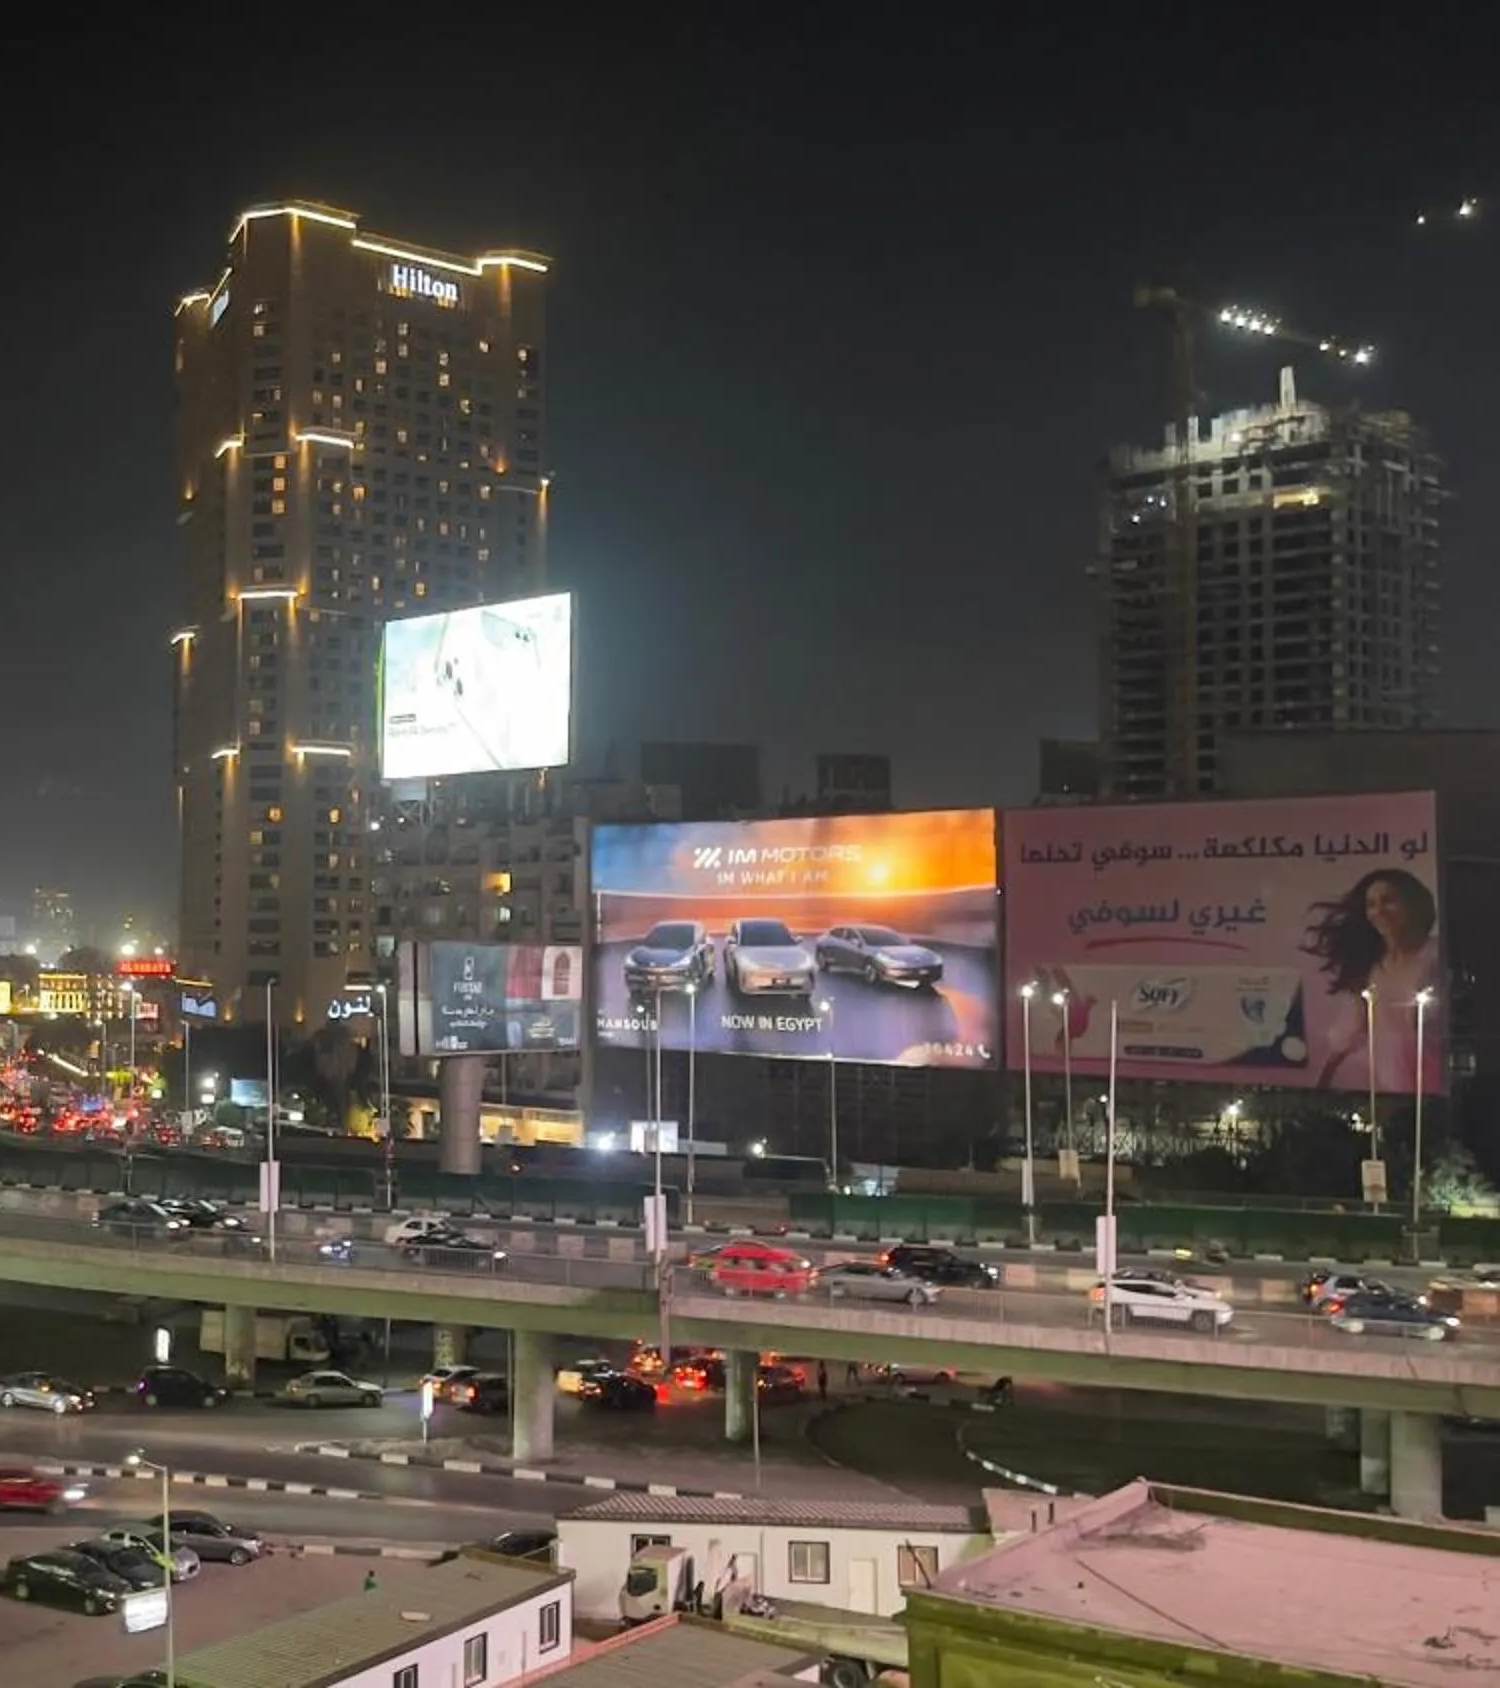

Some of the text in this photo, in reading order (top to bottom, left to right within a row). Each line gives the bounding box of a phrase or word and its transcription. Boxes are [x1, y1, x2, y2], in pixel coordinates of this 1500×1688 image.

[393, 263, 457, 302] Hilton
[728, 844, 863, 865] IM MOTORS
[1315, 831, 1389, 863] الدنيا
[1399, 829, 1428, 861] لو
[716, 871, 735, 886] IM
[740, 870, 784, 885] WHAT
[790, 871, 797, 884] I
[1067, 896, 1267, 936] غيري لسوفي
[721, 1015, 823, 1033] NOW IN EGYPT
